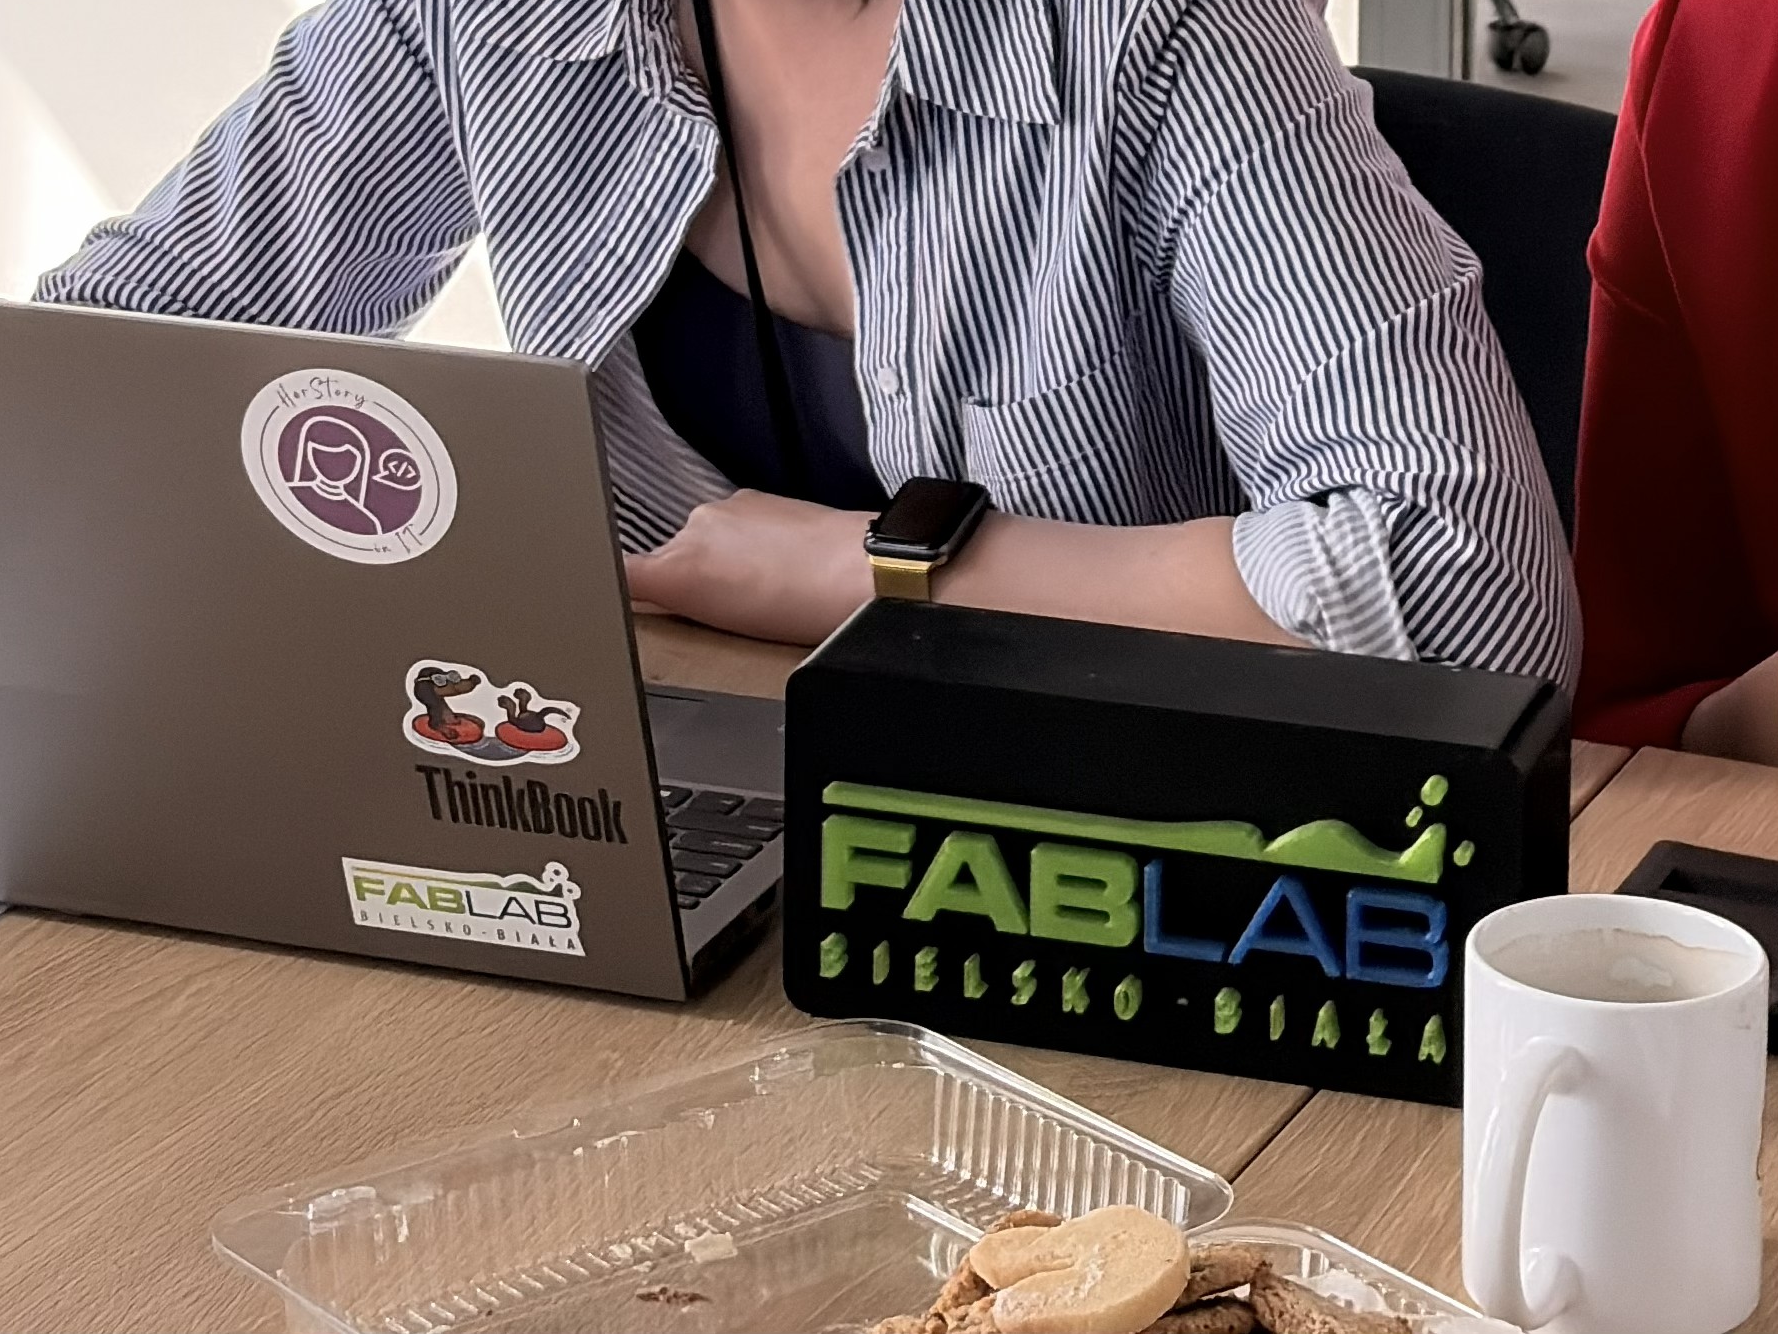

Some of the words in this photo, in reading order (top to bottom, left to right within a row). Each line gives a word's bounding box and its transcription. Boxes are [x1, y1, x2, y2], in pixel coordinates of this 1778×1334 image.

[276, 376, 368, 409] HerStory
[395, 523, 423, 554] IT
[414, 763, 629, 845] ThinkBook
[351, 874, 572, 930] FABLAB
[820, 813, 1449, 989] FABLAB
